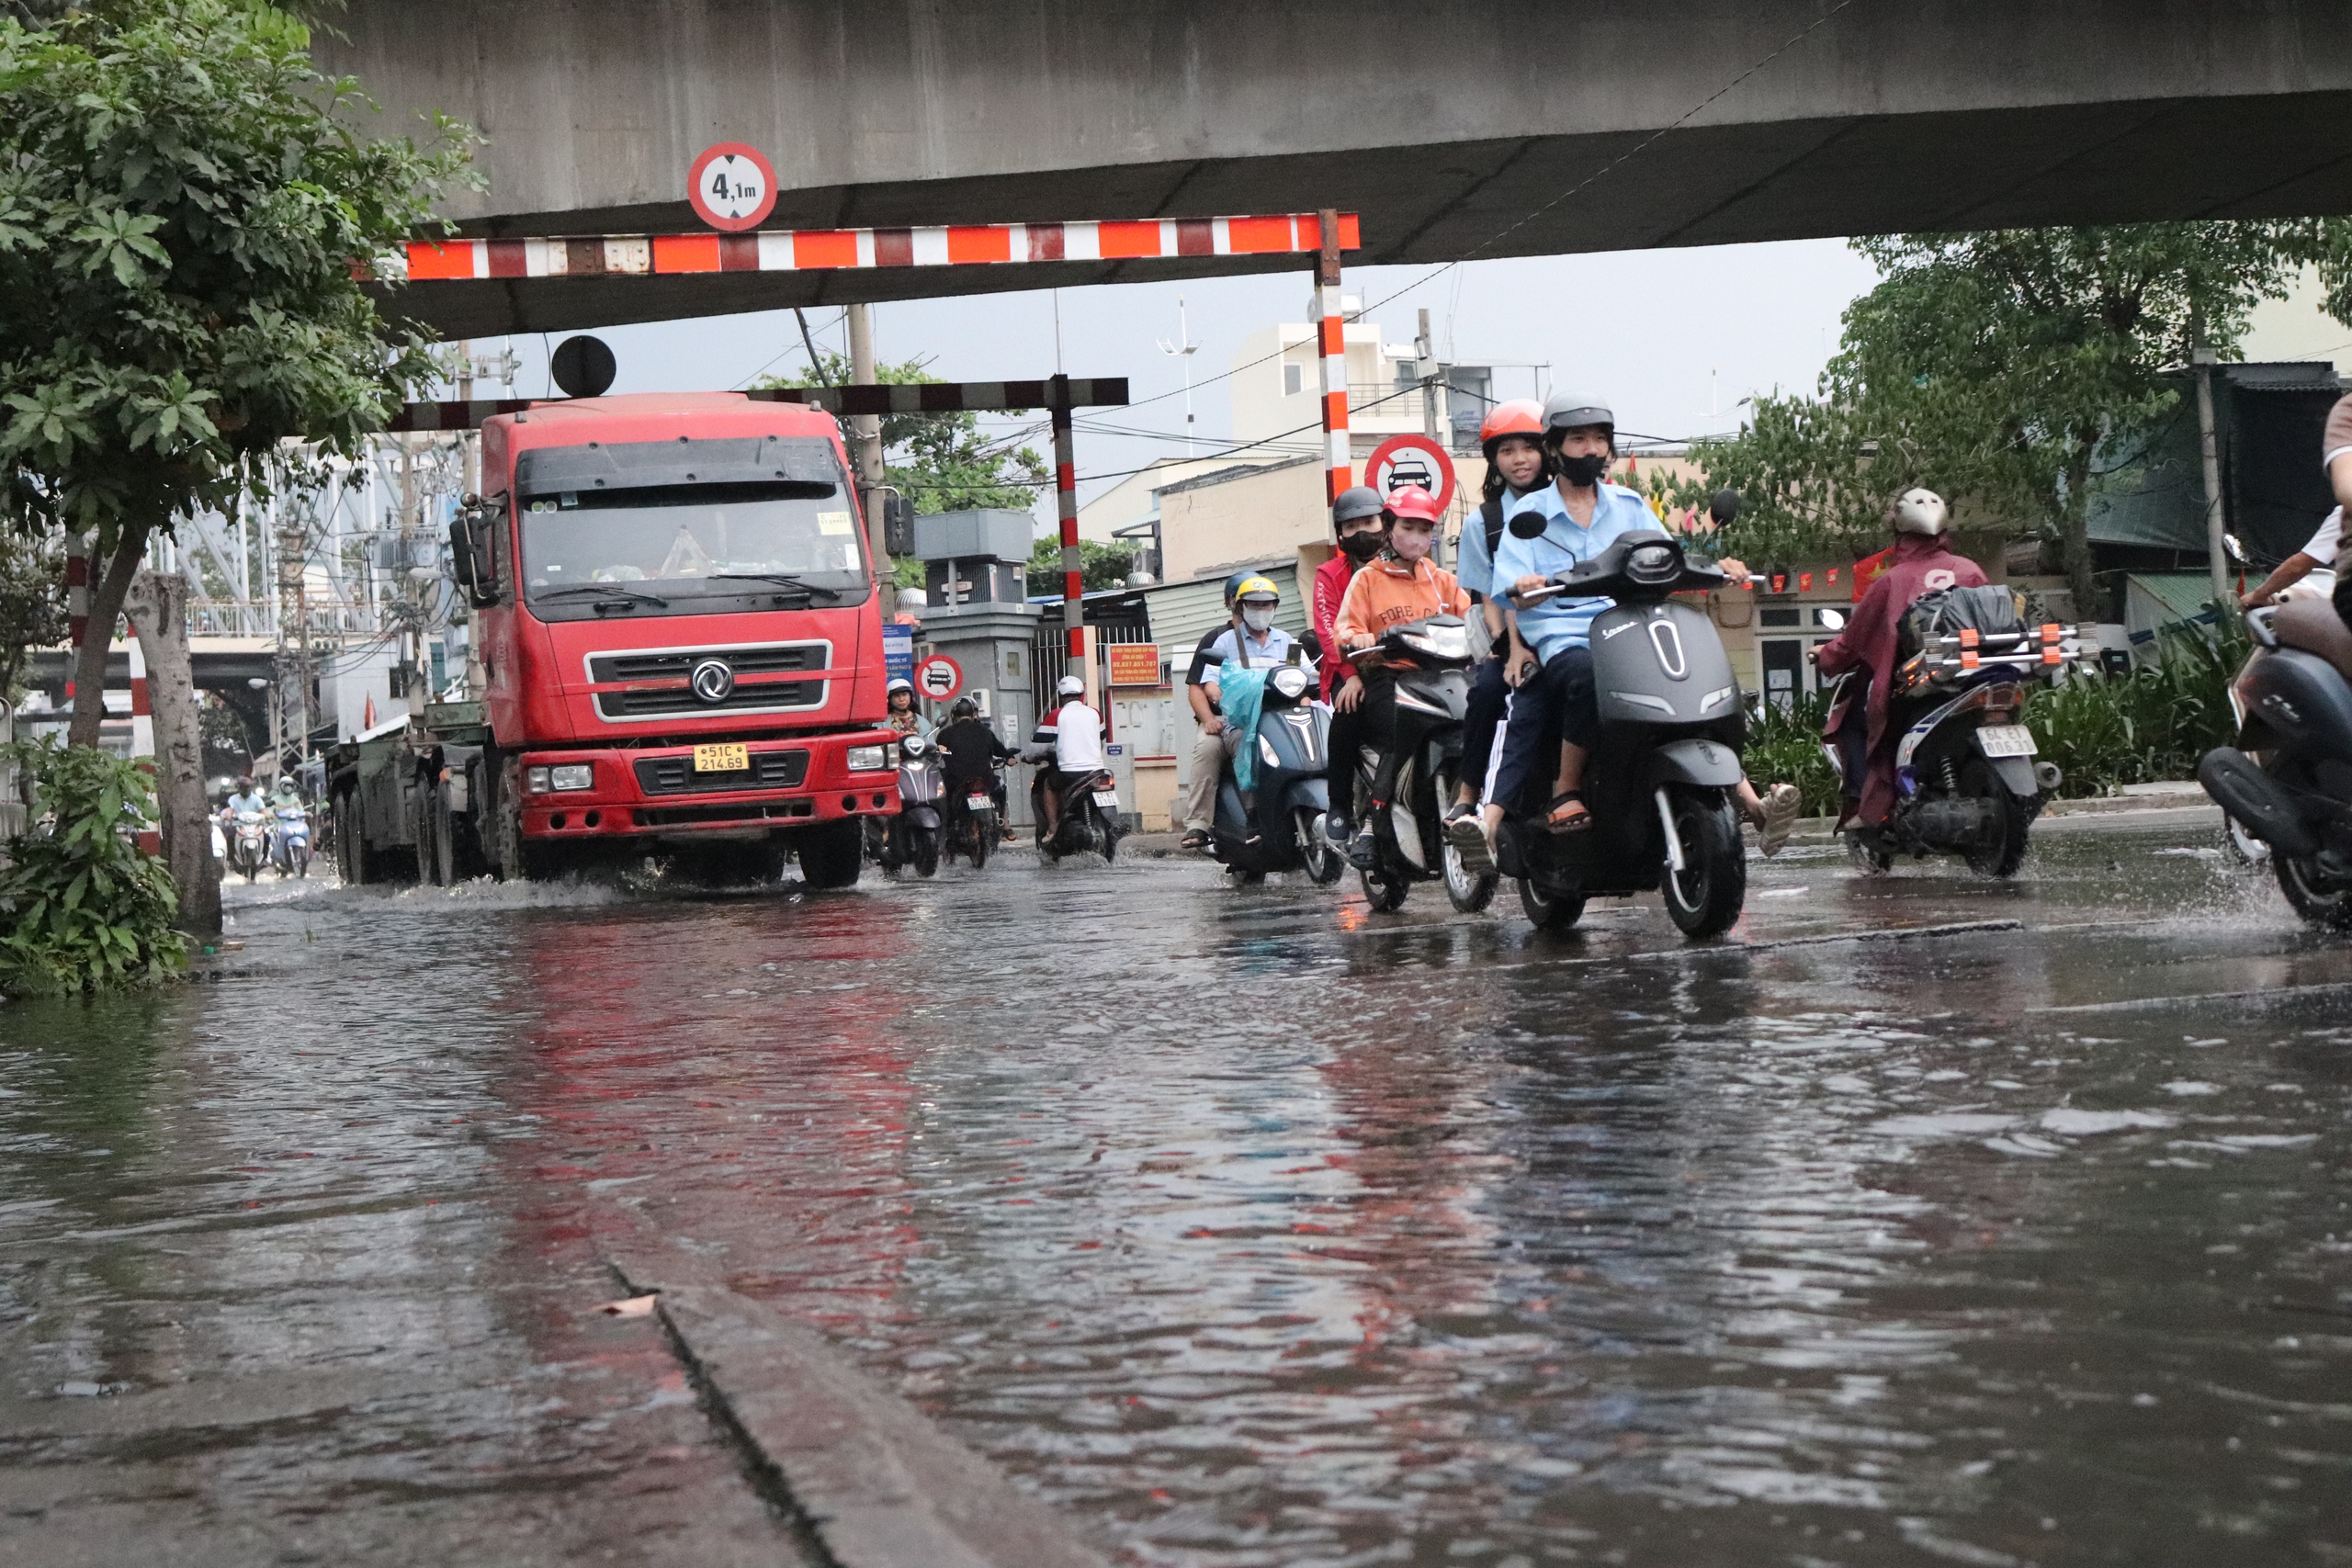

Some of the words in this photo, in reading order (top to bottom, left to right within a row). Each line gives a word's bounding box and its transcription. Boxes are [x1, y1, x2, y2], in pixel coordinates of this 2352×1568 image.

[712, 174, 756, 203] 4,1m
[1379, 606, 1414, 626] FORE
[1985, 728, 2021, 740] 64-E1
[708, 746, 732, 757] 51C
[701, 757, 743, 770] 214.69
